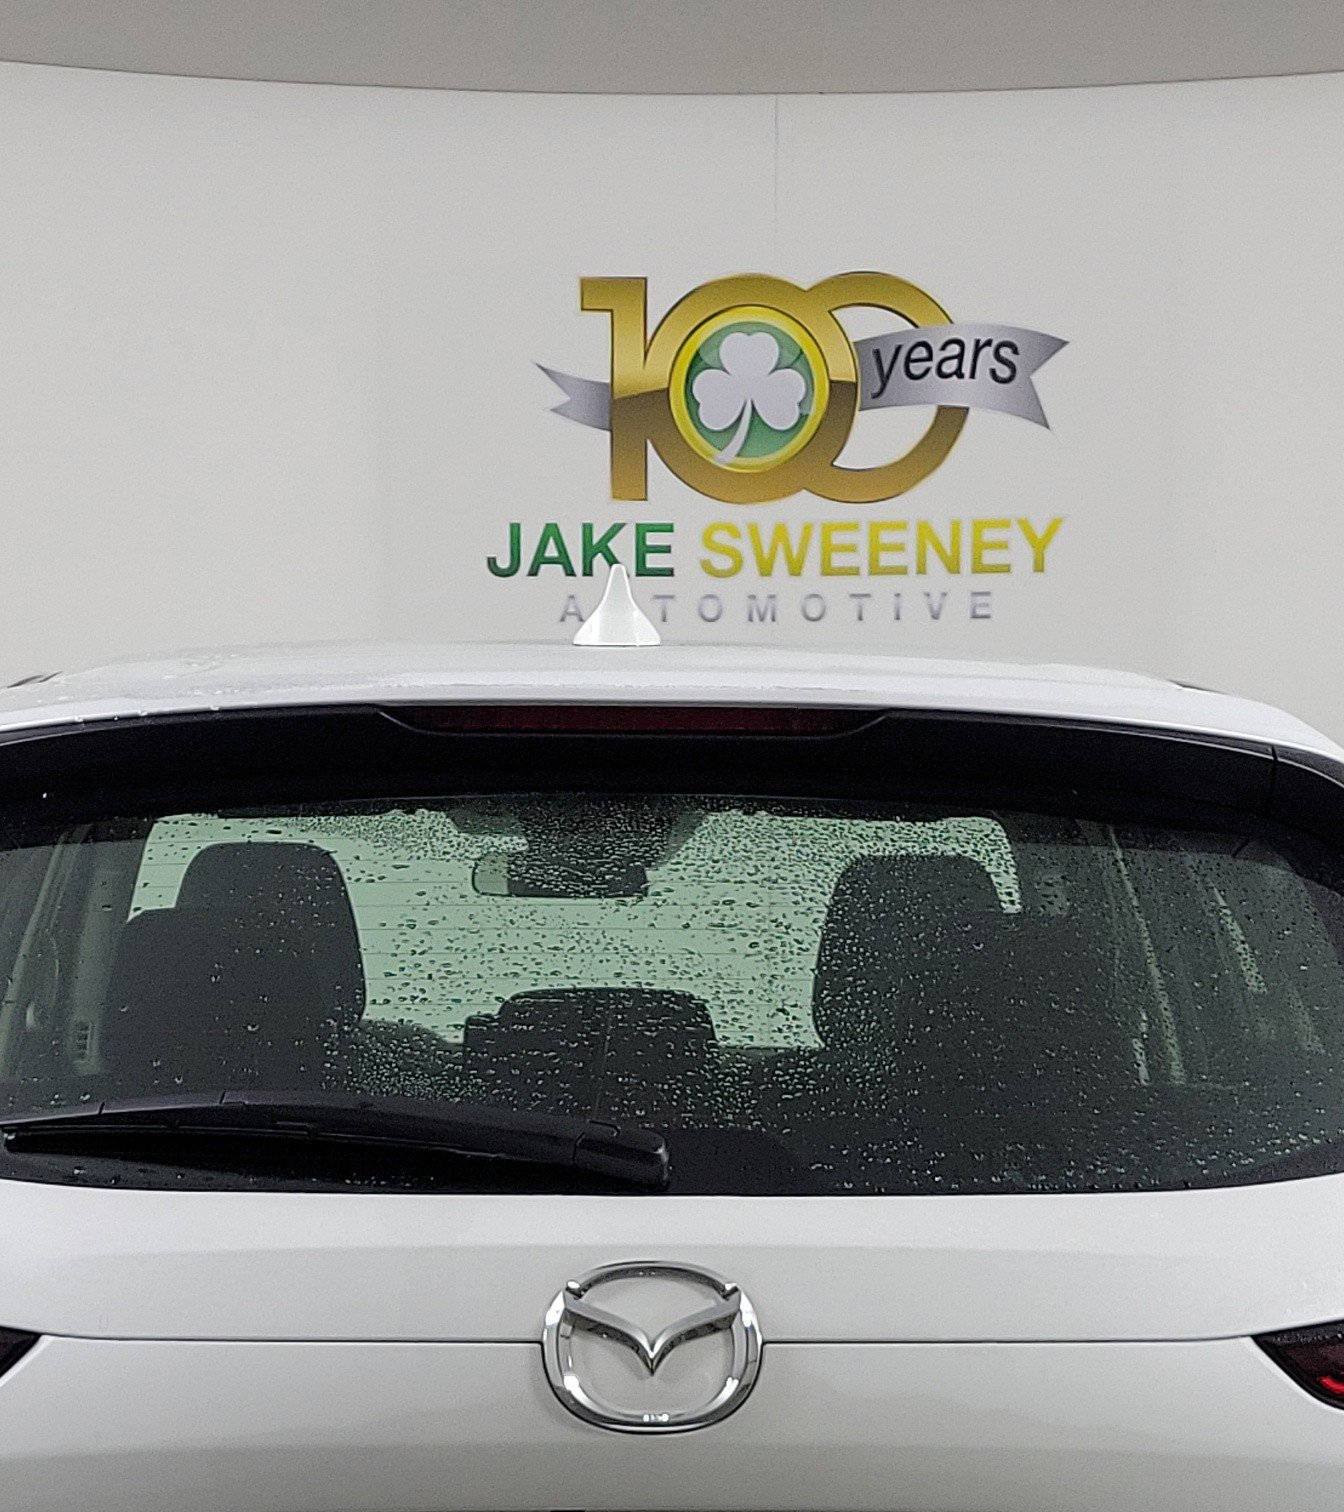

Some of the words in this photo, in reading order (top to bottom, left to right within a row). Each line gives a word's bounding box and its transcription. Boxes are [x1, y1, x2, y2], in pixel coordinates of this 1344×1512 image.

[579, 270, 970, 505] 100
[870, 335, 1021, 400] years
[486, 521, 676, 578] JAKE
[699, 517, 1065, 579] SWEENEY
[559, 591, 994, 624] ATOMOTIVE
